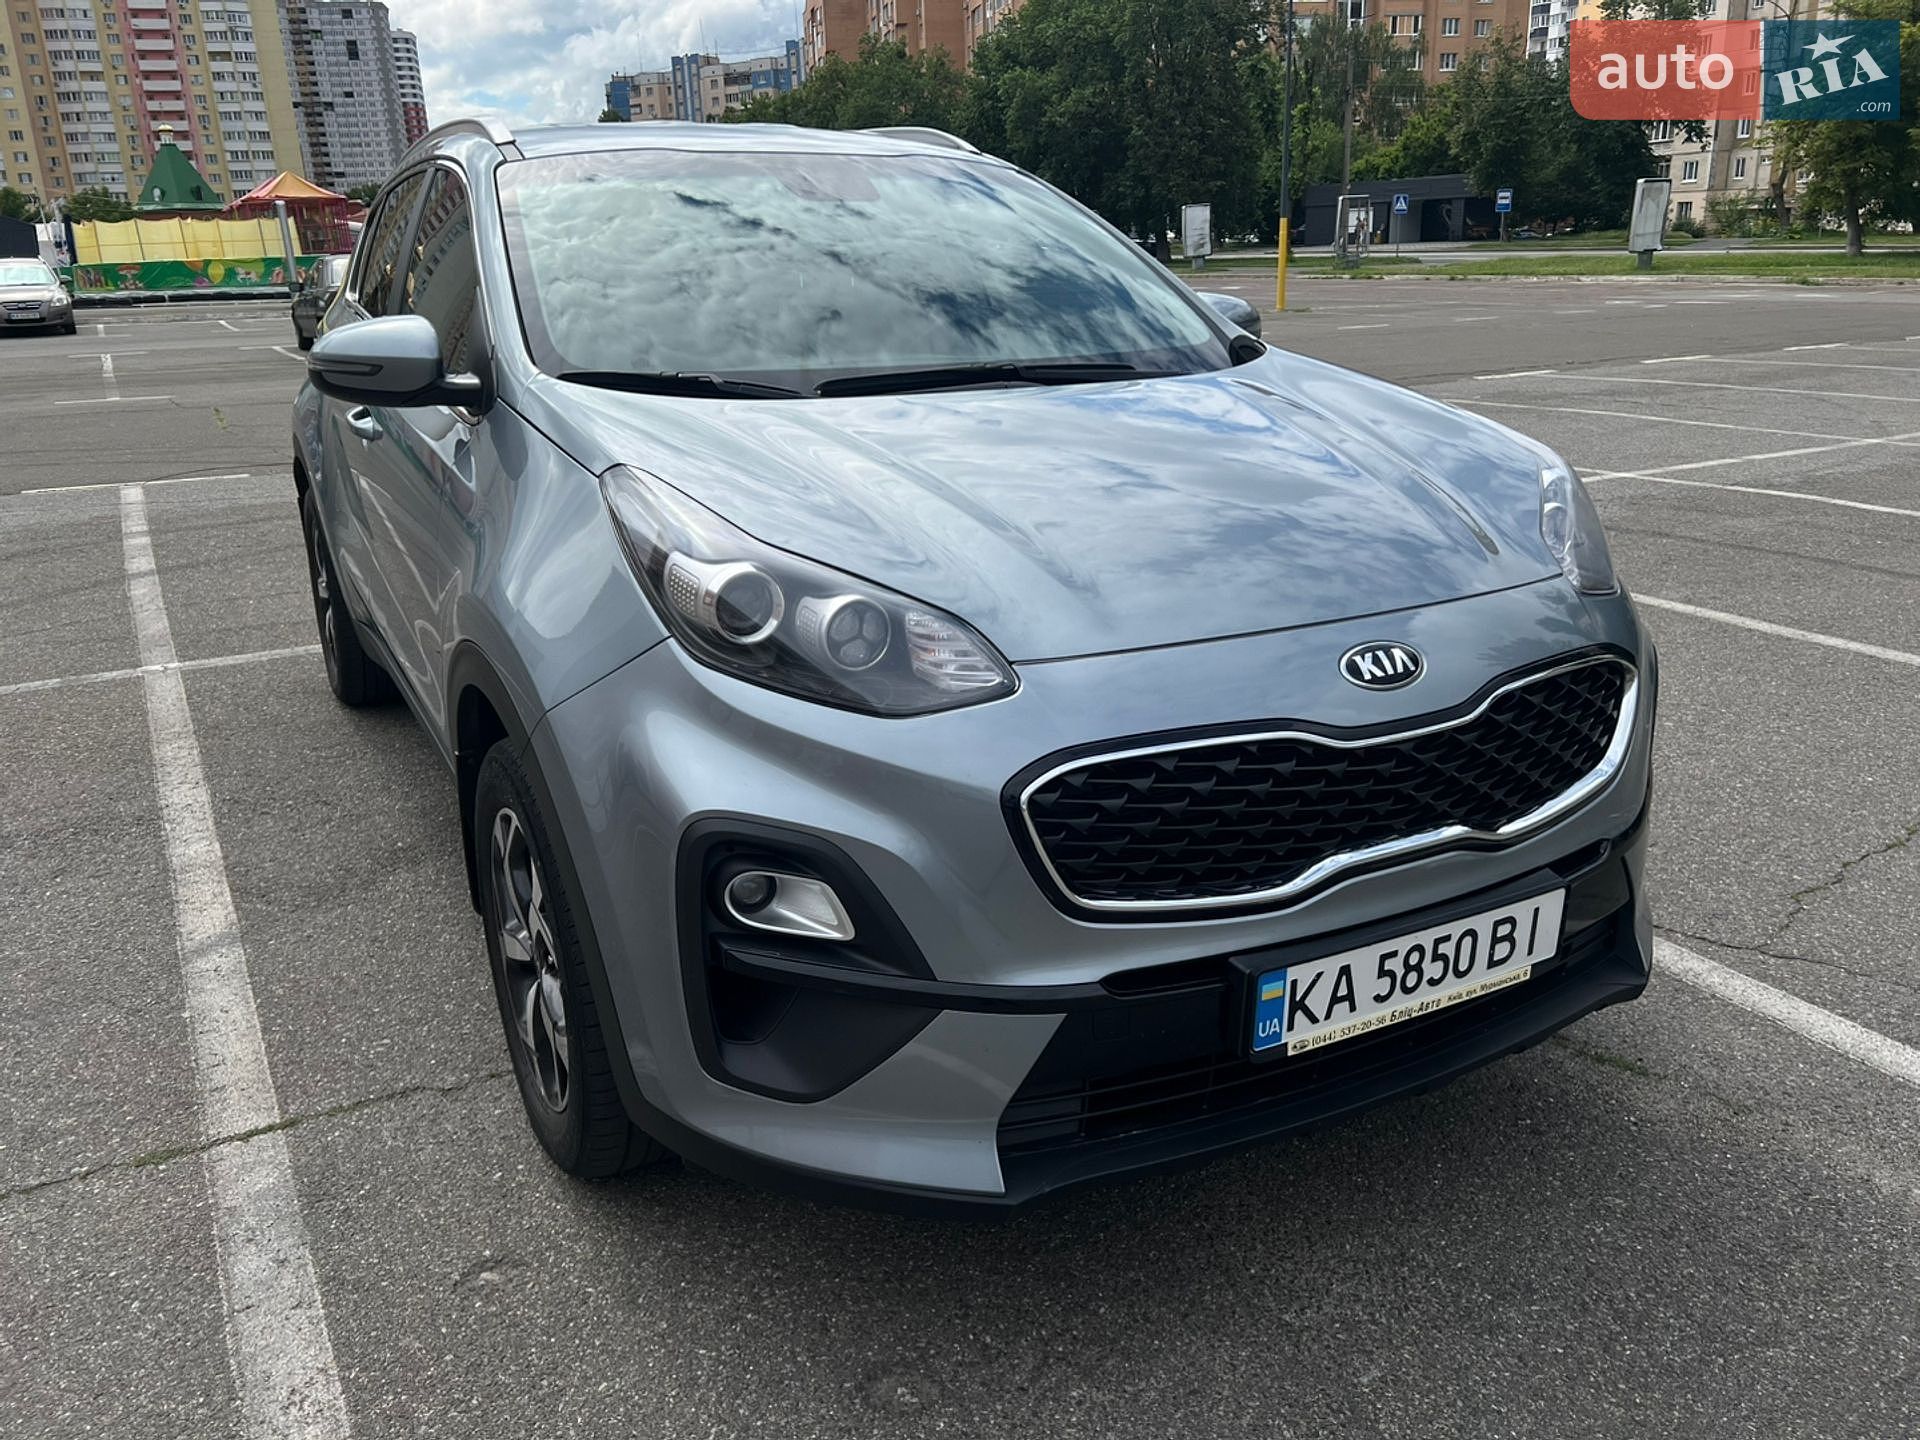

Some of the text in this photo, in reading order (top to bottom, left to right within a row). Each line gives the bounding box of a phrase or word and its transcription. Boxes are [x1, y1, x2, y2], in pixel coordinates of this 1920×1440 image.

[1352, 647, 1416, 680] KIA
[1286, 963, 1357, 1032] KA
[1372, 927, 1478, 1005] 5850
[1258, 1018, 1280, 1037] UA
